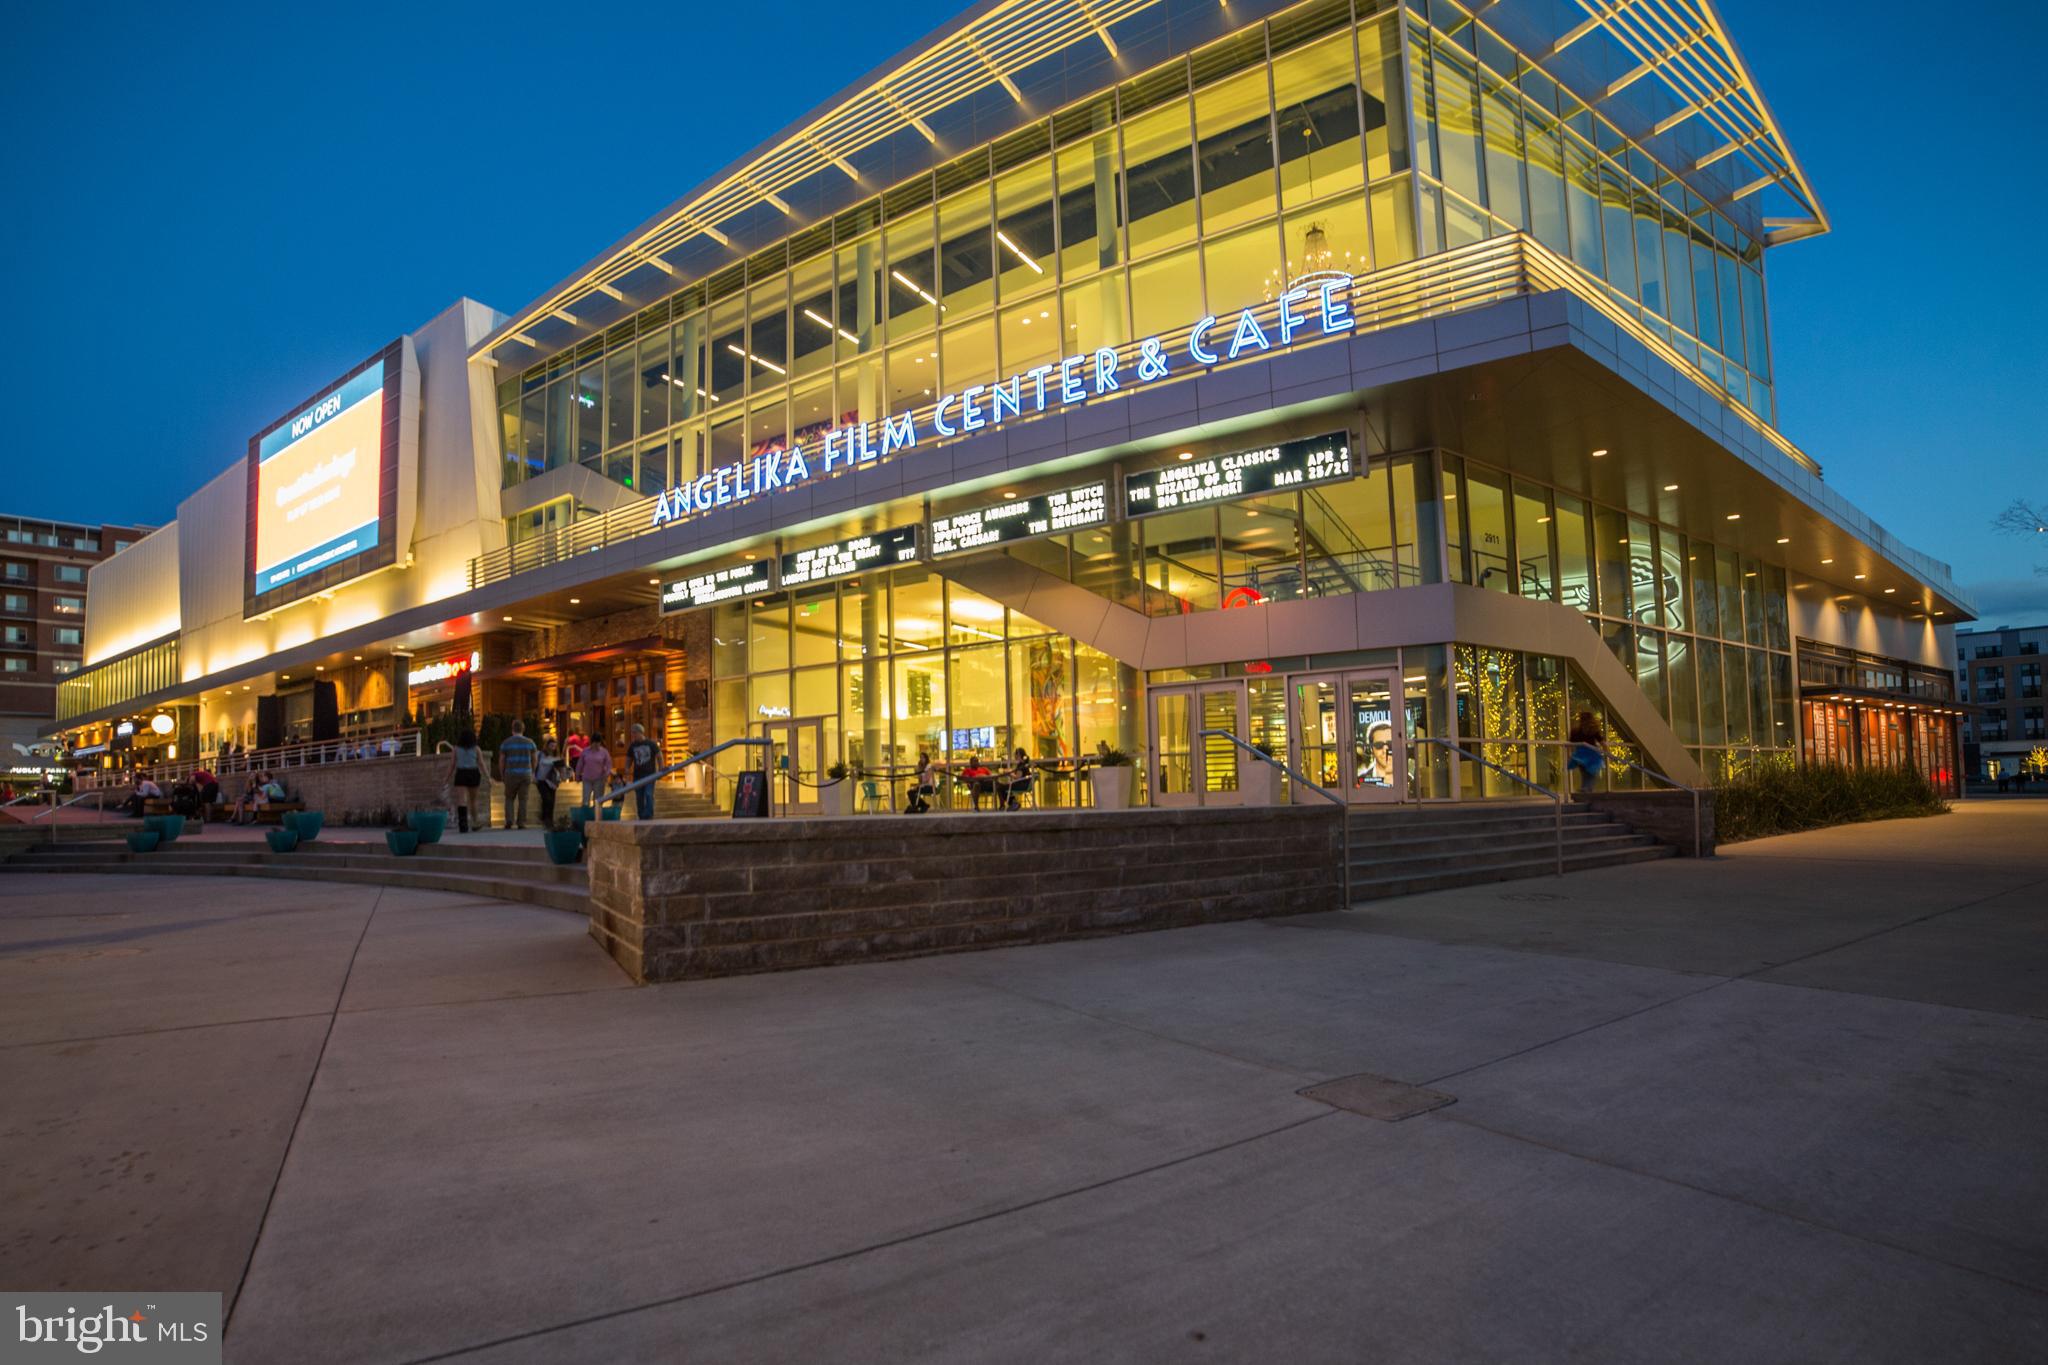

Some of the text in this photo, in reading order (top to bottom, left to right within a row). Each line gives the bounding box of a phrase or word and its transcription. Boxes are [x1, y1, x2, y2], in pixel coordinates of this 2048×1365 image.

[653, 277, 1355, 526] ANGELIKA FILM CENTER & CAFE
[291, 394, 341, 439] NOW OPEN
[1160, 447, 1280, 484] ANGELIKA CLASSICS
[1307, 447, 1348, 467] APR 2
[1129, 468, 1242, 502] THE WIZARD OF OZ
[1274, 469, 1302, 486] MAR
[1048, 485, 1103, 507] THE WITCH
[1157, 481, 1242, 509] BIG LEBOWSKI
[1051, 497, 1104, 518] DEADPOOL
[934, 522, 983, 542] SPOTLIGHT
[1028, 520, 1047, 534] THE
[1484, 532, 1500, 545] 2911
